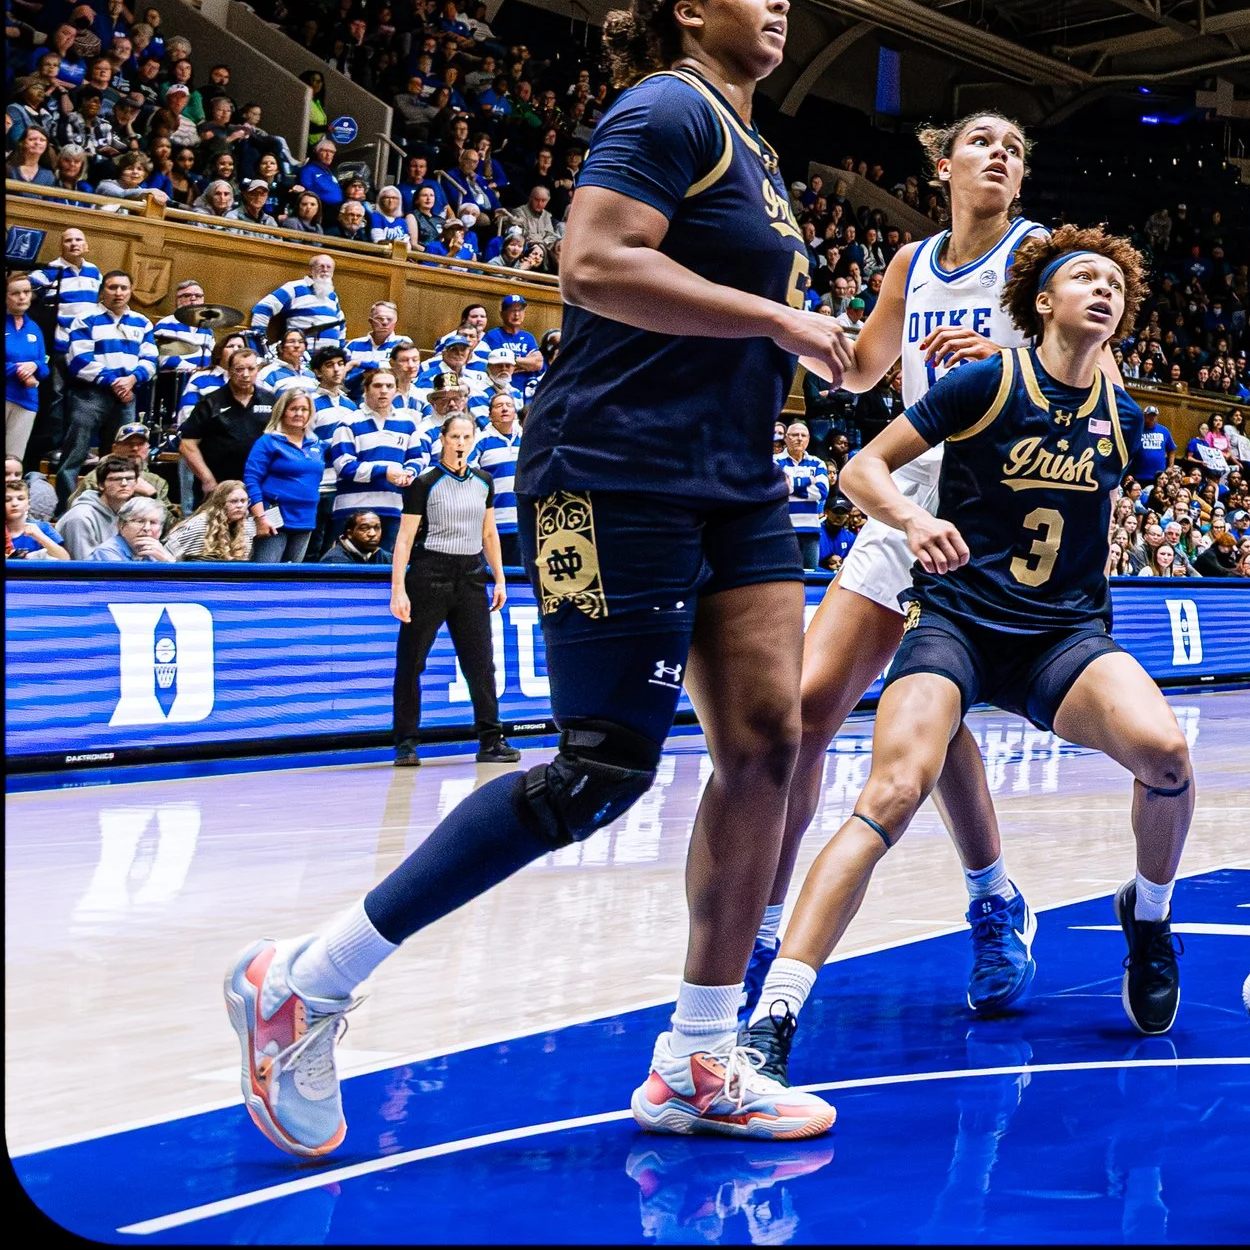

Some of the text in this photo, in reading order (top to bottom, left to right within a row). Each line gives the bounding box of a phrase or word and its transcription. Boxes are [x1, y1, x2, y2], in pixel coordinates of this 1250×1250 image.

[136, 261, 158, 293] 17
[909, 308, 991, 343] DUKE
[1002, 437, 1098, 487] Irish
[1010, 507, 1064, 587] 3
[65, 753, 115, 764] DAKTRONICS
